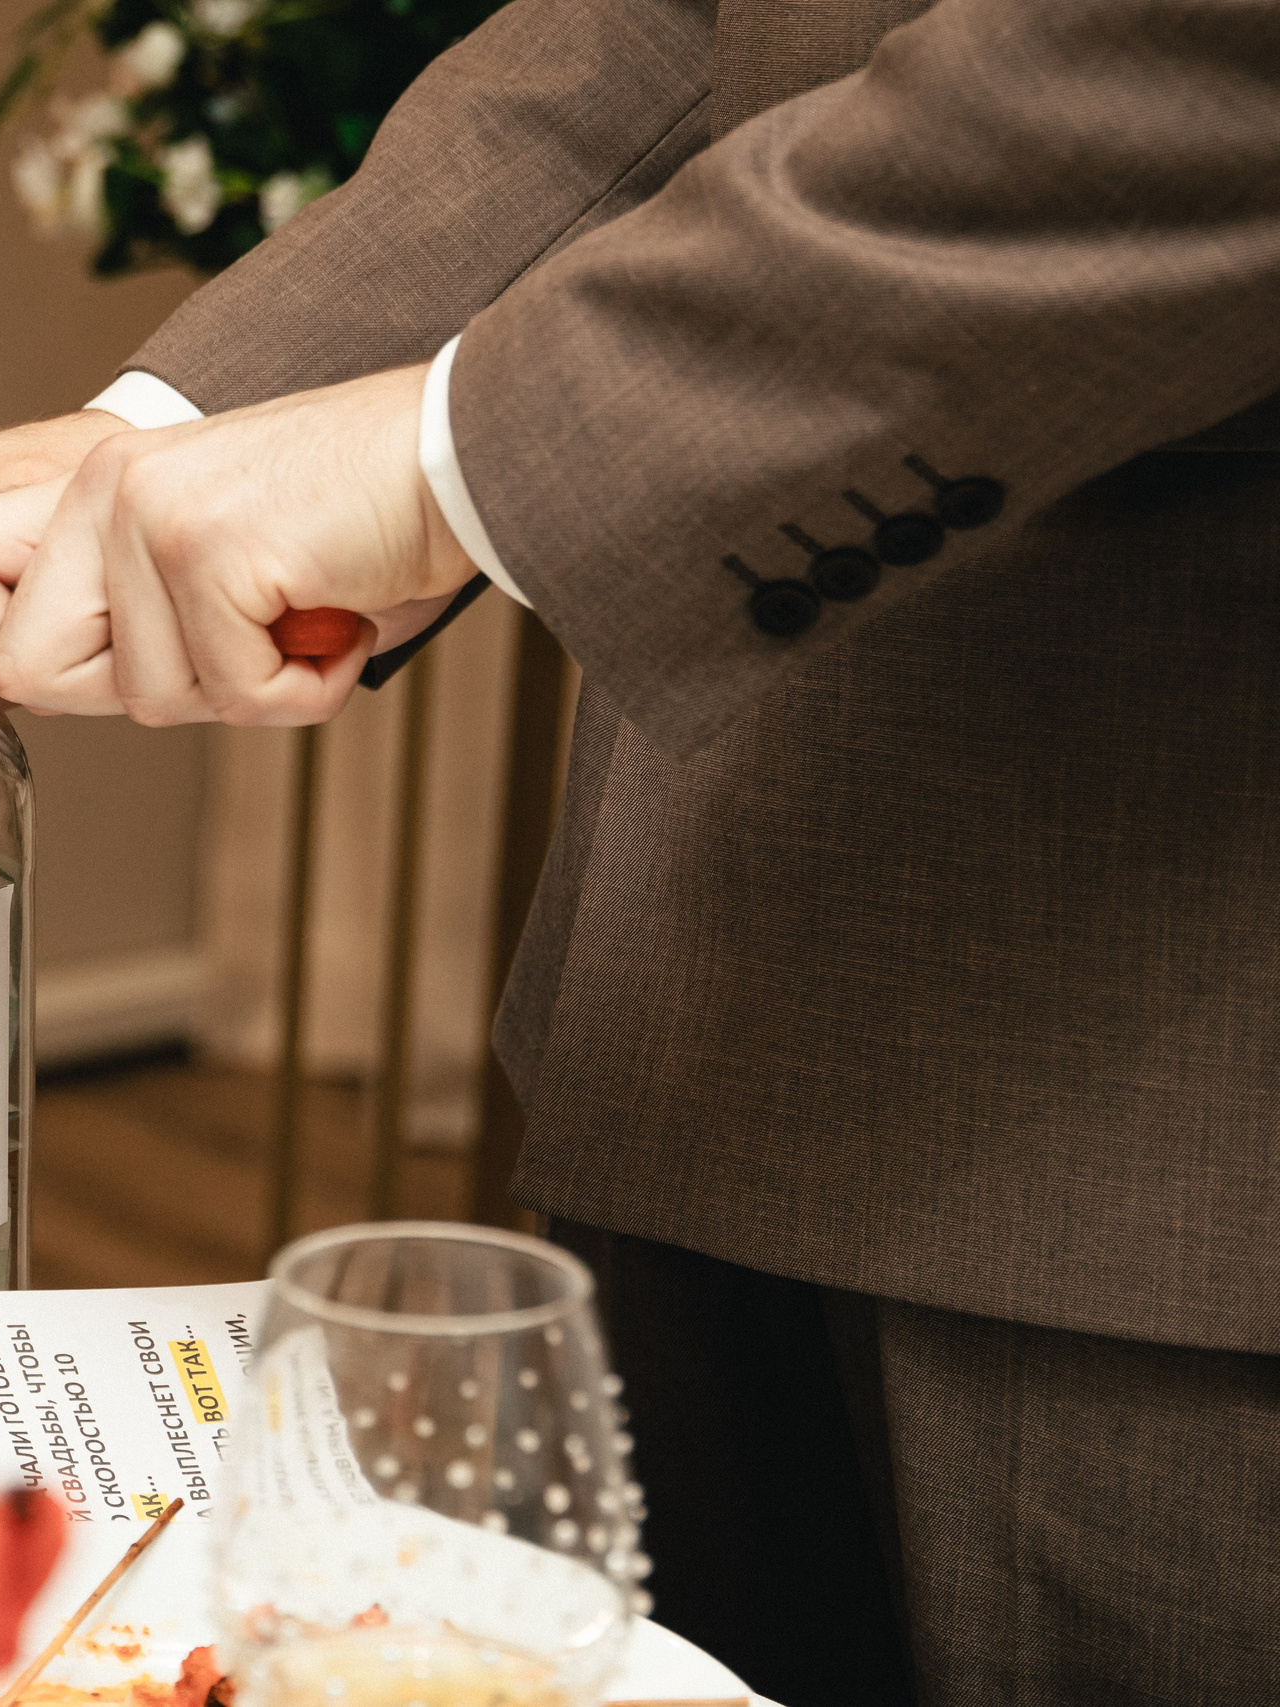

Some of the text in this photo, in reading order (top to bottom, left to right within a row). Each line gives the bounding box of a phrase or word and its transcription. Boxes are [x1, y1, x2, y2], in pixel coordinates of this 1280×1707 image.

[7, 1323, 47, 1394] ЧТОБЫ
[54, 1353, 79, 1375] 10
[127, 1320, 164, 1375] СВОИ
[177, 1325, 207, 1379] ТАК...
[193, 1384, 224, 1422] ВОТ
[36, 1399, 87, 1504] СВАДЬБЫ,
[64, 1382, 125, 1508] СКОРОСТЬЮ
[149, 1381, 211, 1501] ВЫПЛЕСНЕТ
